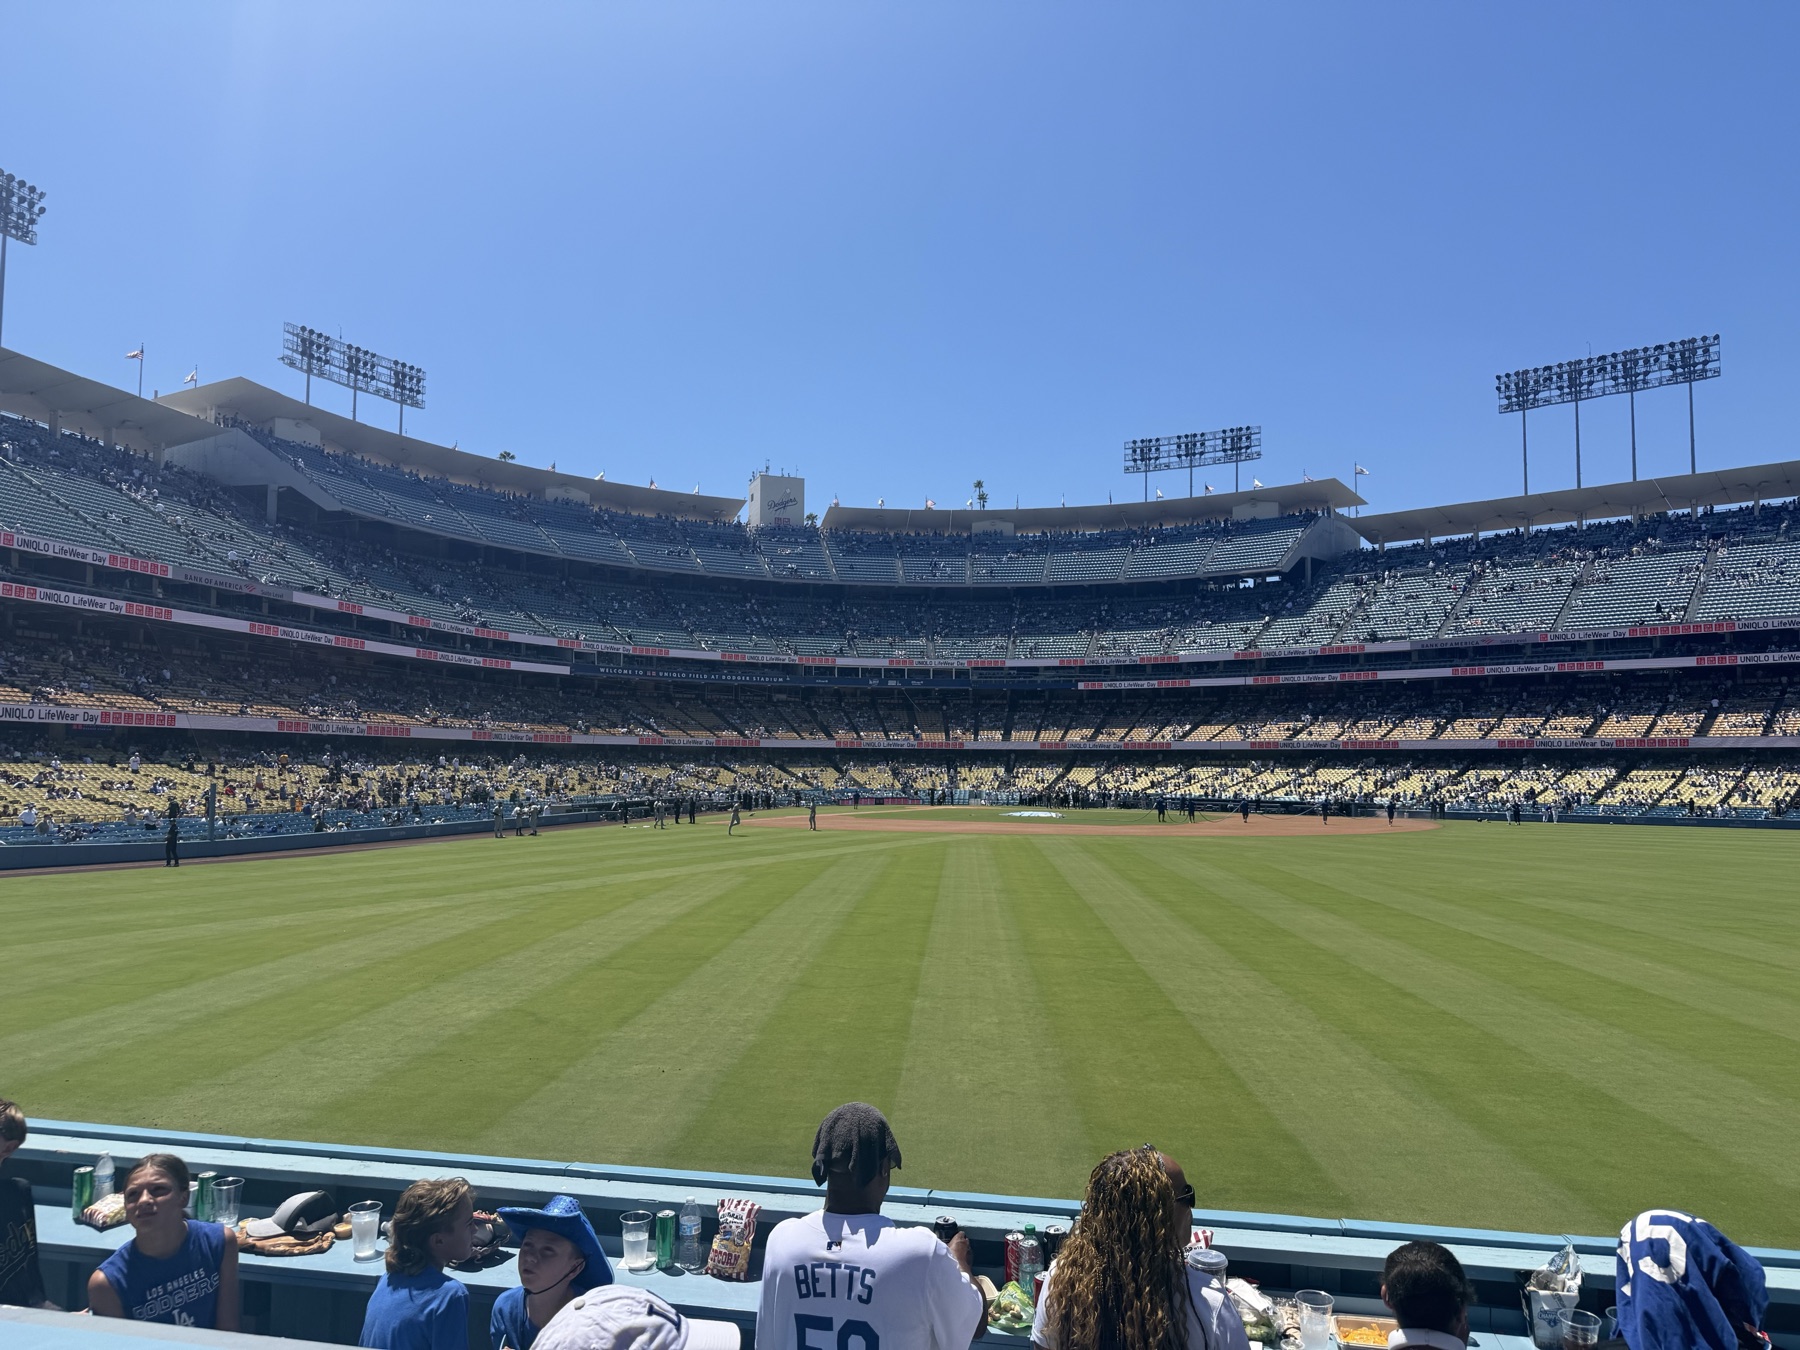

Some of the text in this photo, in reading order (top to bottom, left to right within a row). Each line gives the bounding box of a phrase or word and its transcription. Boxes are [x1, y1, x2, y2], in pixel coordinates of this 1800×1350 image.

[768, 497, 798, 511] Dodgers
[17, 537, 106, 565] UNIQLO LifeWear Day
[184, 574, 243, 592] BANK OF AMERICA
[39, 590, 70, 604] UNIQLO
[72, 596, 106, 610] LifeWear
[110, 601, 124, 614] Day
[466, 627, 474, 635] Day
[1738, 621, 1768, 630] UNIQLO
[1772, 620, 1800, 628] LifeWe
[280, 628, 300, 639] UNIQLO
[300, 631, 323, 642] LifeWear
[324, 635, 334, 646] Day
[1550, 632, 1576, 640] UNIQLO
[1578, 631, 1610, 639] LifeWear
[1613, 630, 1626, 638] Day
[583, 642, 599, 650] UNIQLO
[600, 644, 621, 652] LifeWear
[1262, 650, 1282, 658] UNIQLO
[1308, 648, 1318, 656] Day
[474, 658, 482, 666] Day
[1740, 655, 1770, 663] UNIQLO
[1772, 654, 1800, 662] LifeWe
[600, 667, 632, 675] WELCOME
[1544, 664, 1556, 672] Day
[0, 707, 99, 724] UNIQLO LifeWear Day
[310, 722, 330, 732] UNIQLO
[332, 724, 354, 734] LifeWear
[356, 726, 366, 736] Day
[862, 740, 916, 748] UNIQLO LifeWear Day
[1536, 740, 1614, 748] UNIQLO LifeWear Day
[710, 1248, 740, 1268] OPCORN
[146, 1268, 206, 1300] LOS ANGELES
[794, 1262, 876, 1305] BETTS
[132, 1272, 220, 1321] DODGERS
